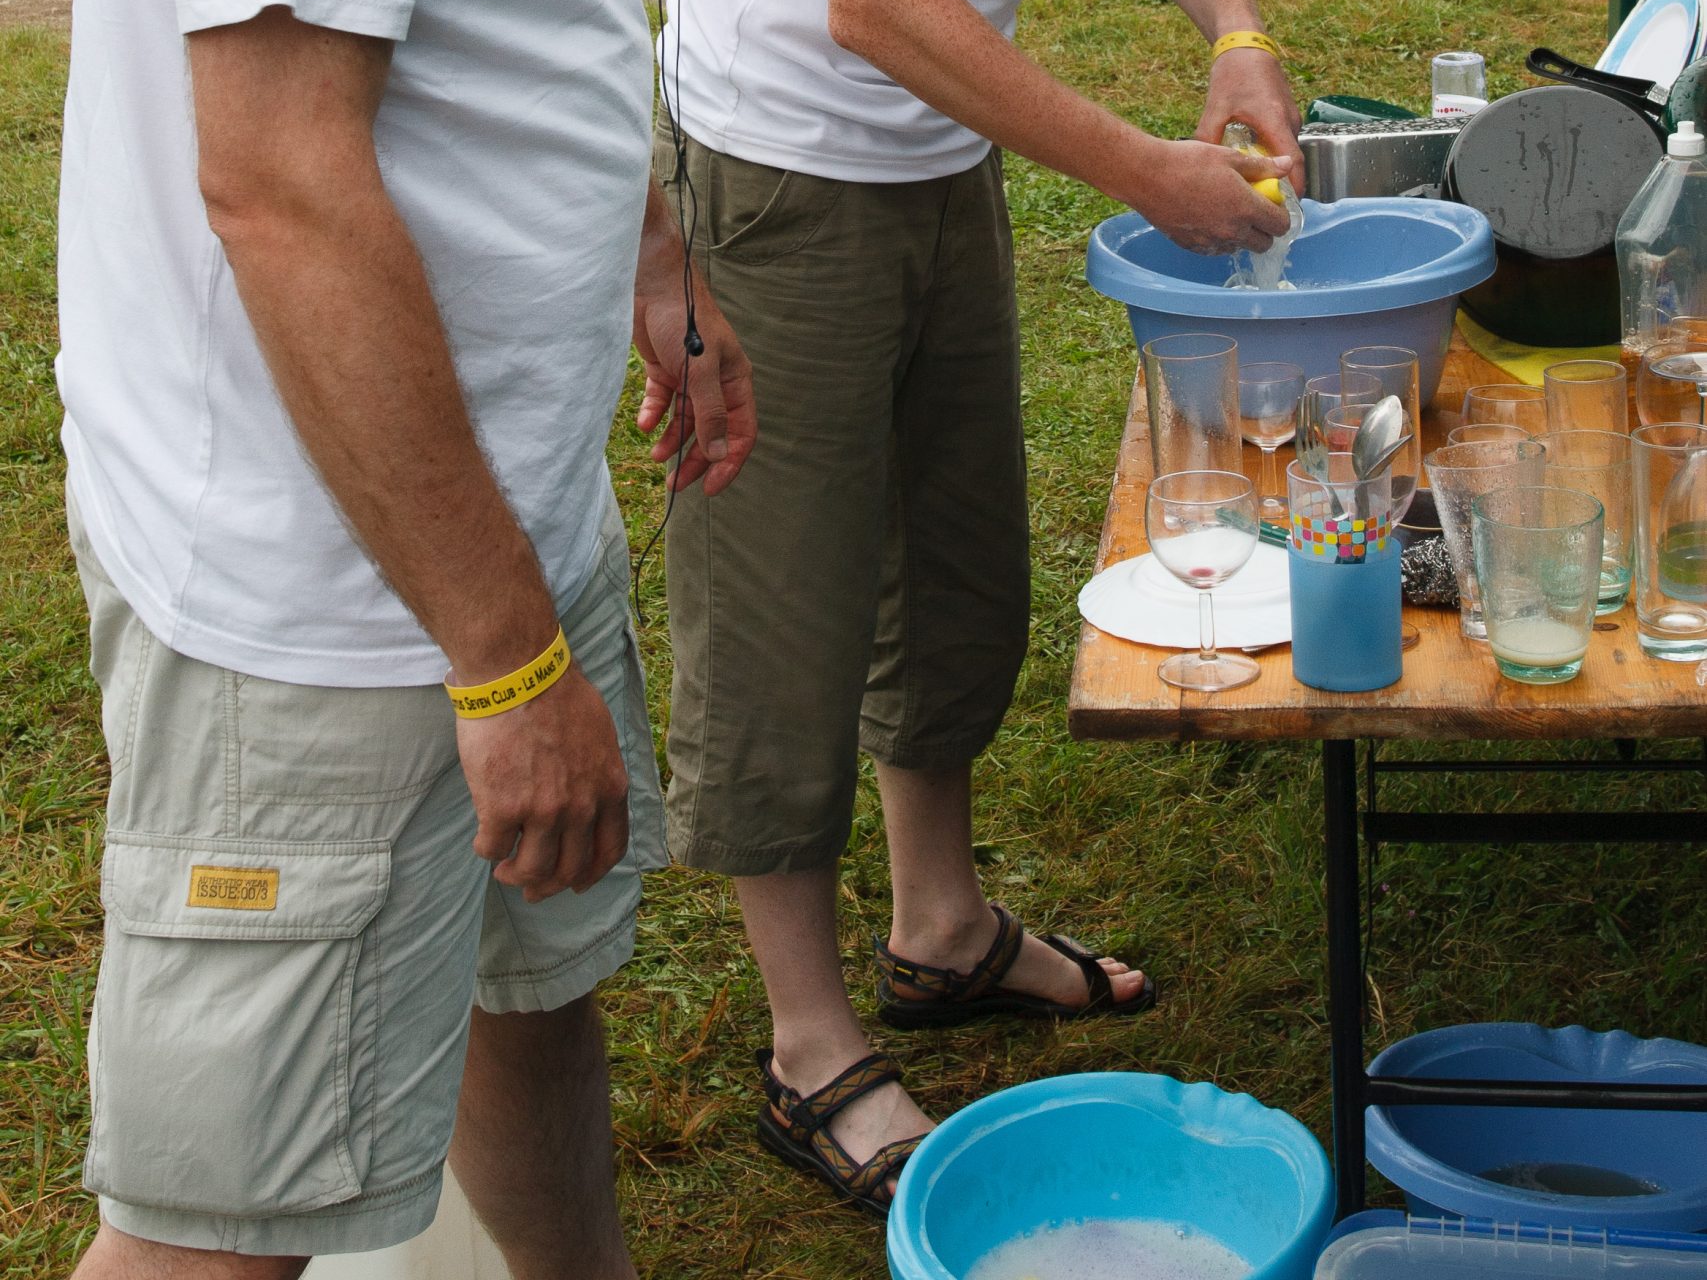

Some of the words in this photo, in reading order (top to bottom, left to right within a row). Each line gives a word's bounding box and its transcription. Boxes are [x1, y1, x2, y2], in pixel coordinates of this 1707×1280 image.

[491, 690, 516, 704] CLUB
[521, 677, 536, 692] LE
[534, 661, 556, 683] MANS
